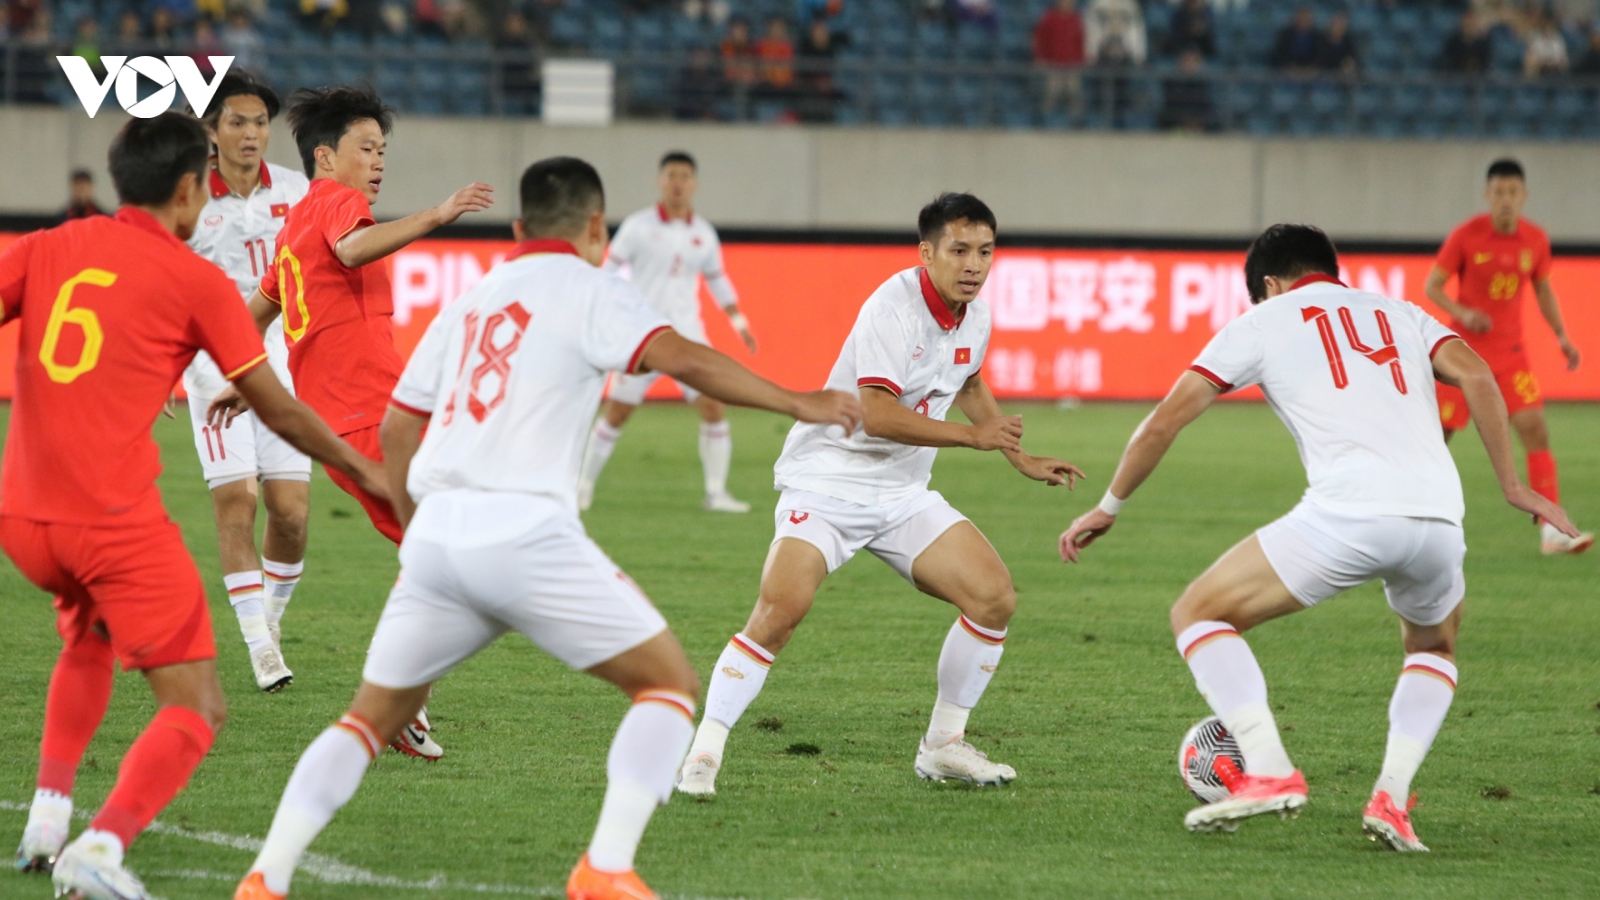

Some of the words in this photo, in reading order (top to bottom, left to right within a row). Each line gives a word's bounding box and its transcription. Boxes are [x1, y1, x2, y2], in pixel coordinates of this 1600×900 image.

[244, 238, 269, 277] 11
[979, 256, 1157, 333] 国平安
[38, 267, 119, 385] 6
[442, 301, 534, 426] 18
[1300, 305, 1409, 396] 14
[202, 424, 226, 462] 11
